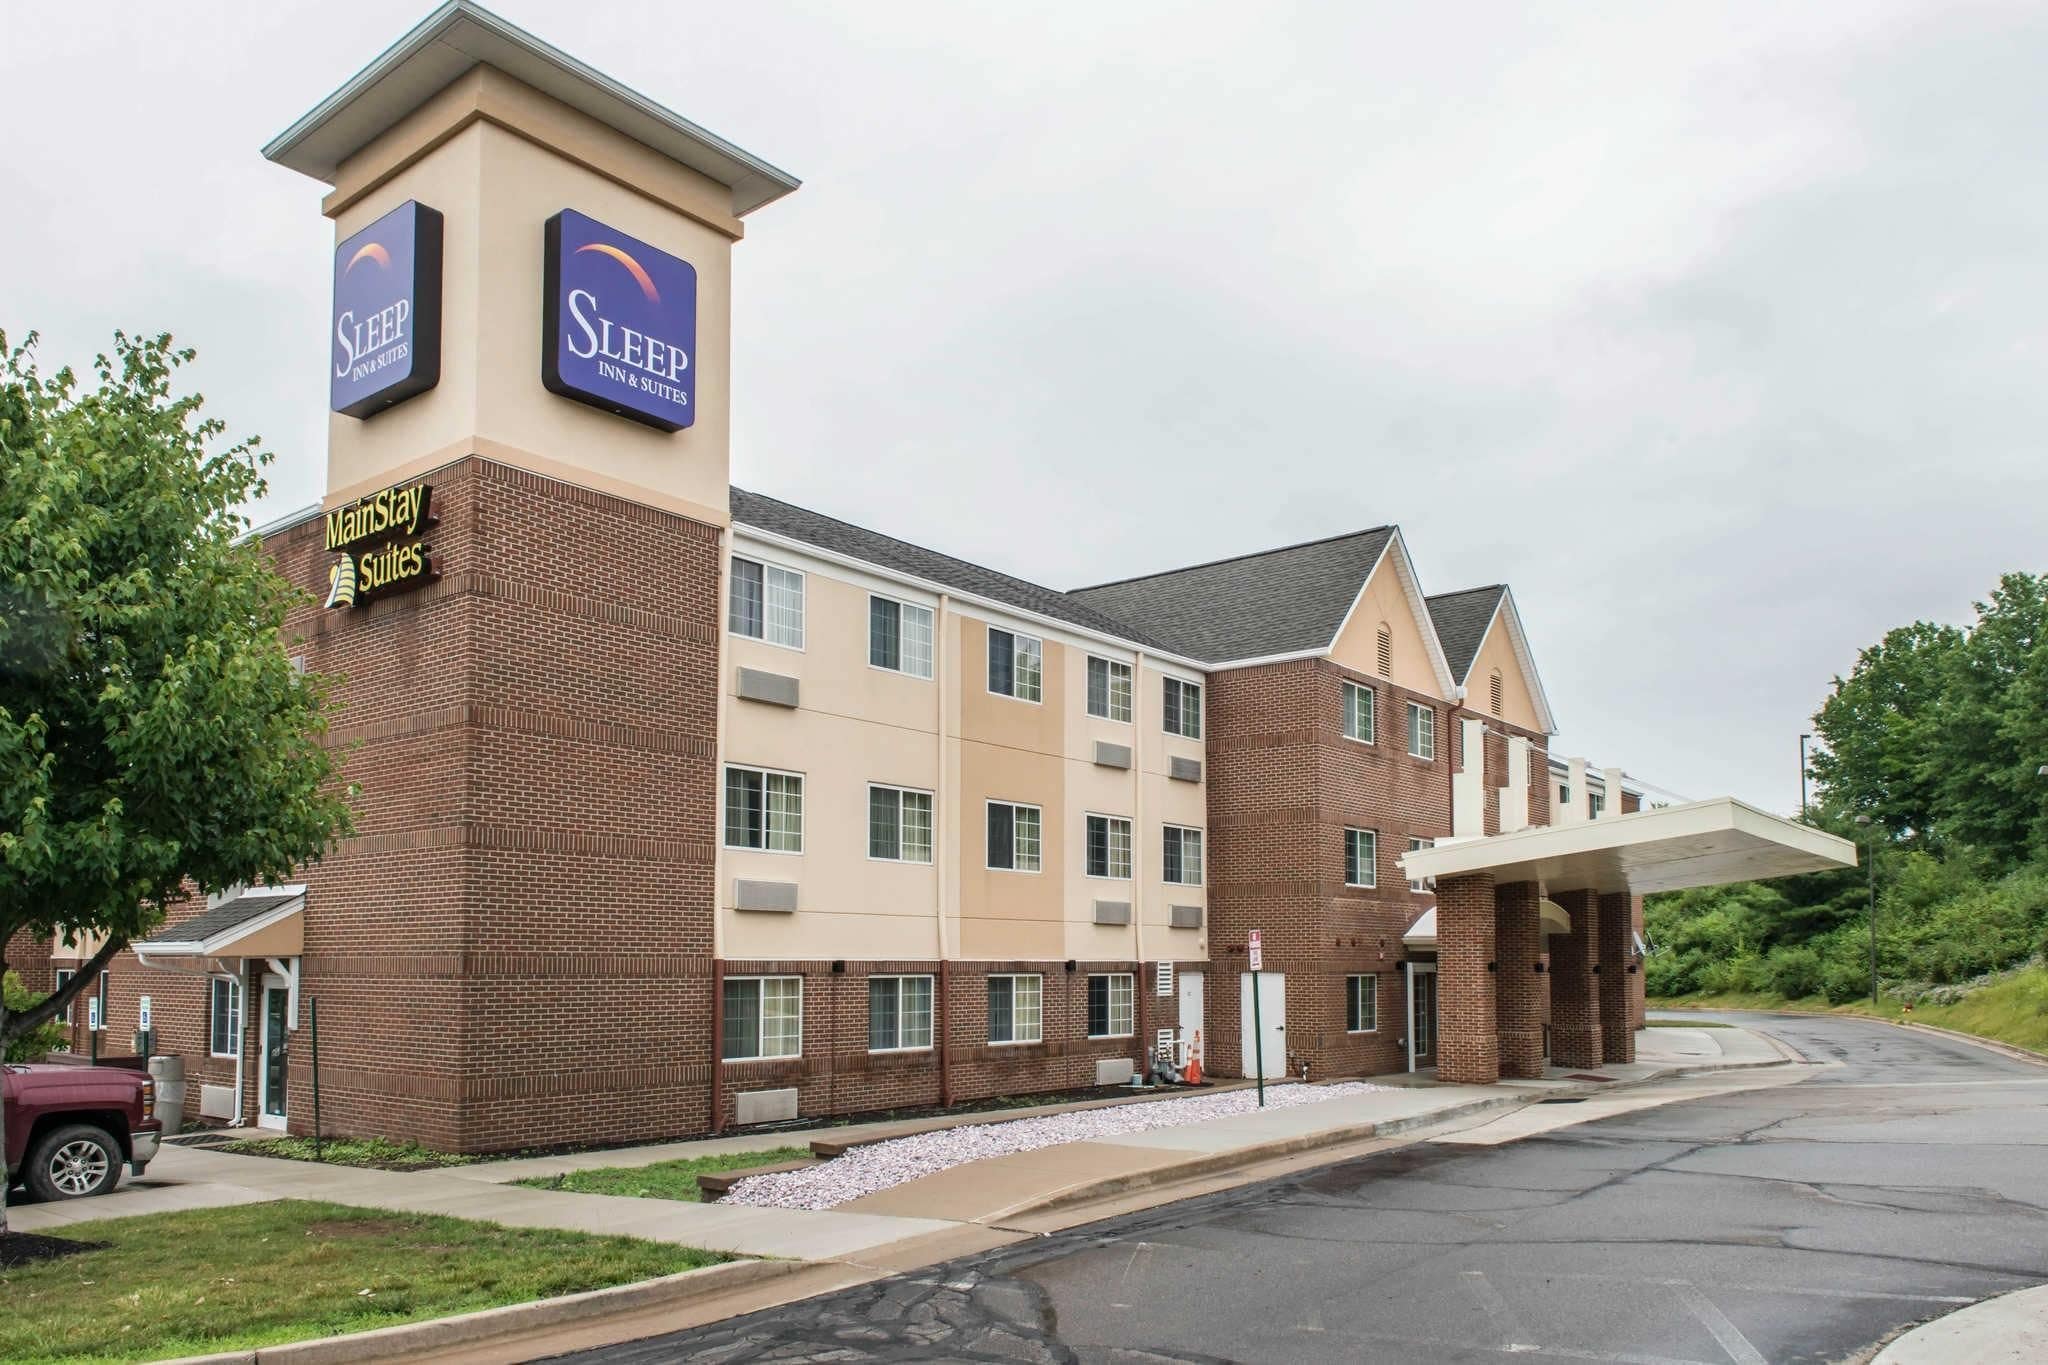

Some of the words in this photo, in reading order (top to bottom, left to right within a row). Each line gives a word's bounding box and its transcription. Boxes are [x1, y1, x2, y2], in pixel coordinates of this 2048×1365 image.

[336, 299, 409, 378] SLEEP
[353, 361, 369, 382] INN
[370, 359, 376, 373] &
[377, 341, 408, 368] SUITES
[567, 289, 688, 383] SLEEP
[598, 360, 626, 383] INN
[628, 373, 638, 388] &
[640, 377, 688, 406] SUITES
[325, 484, 424, 550] MainStay
[359, 541, 422, 592] Suites
